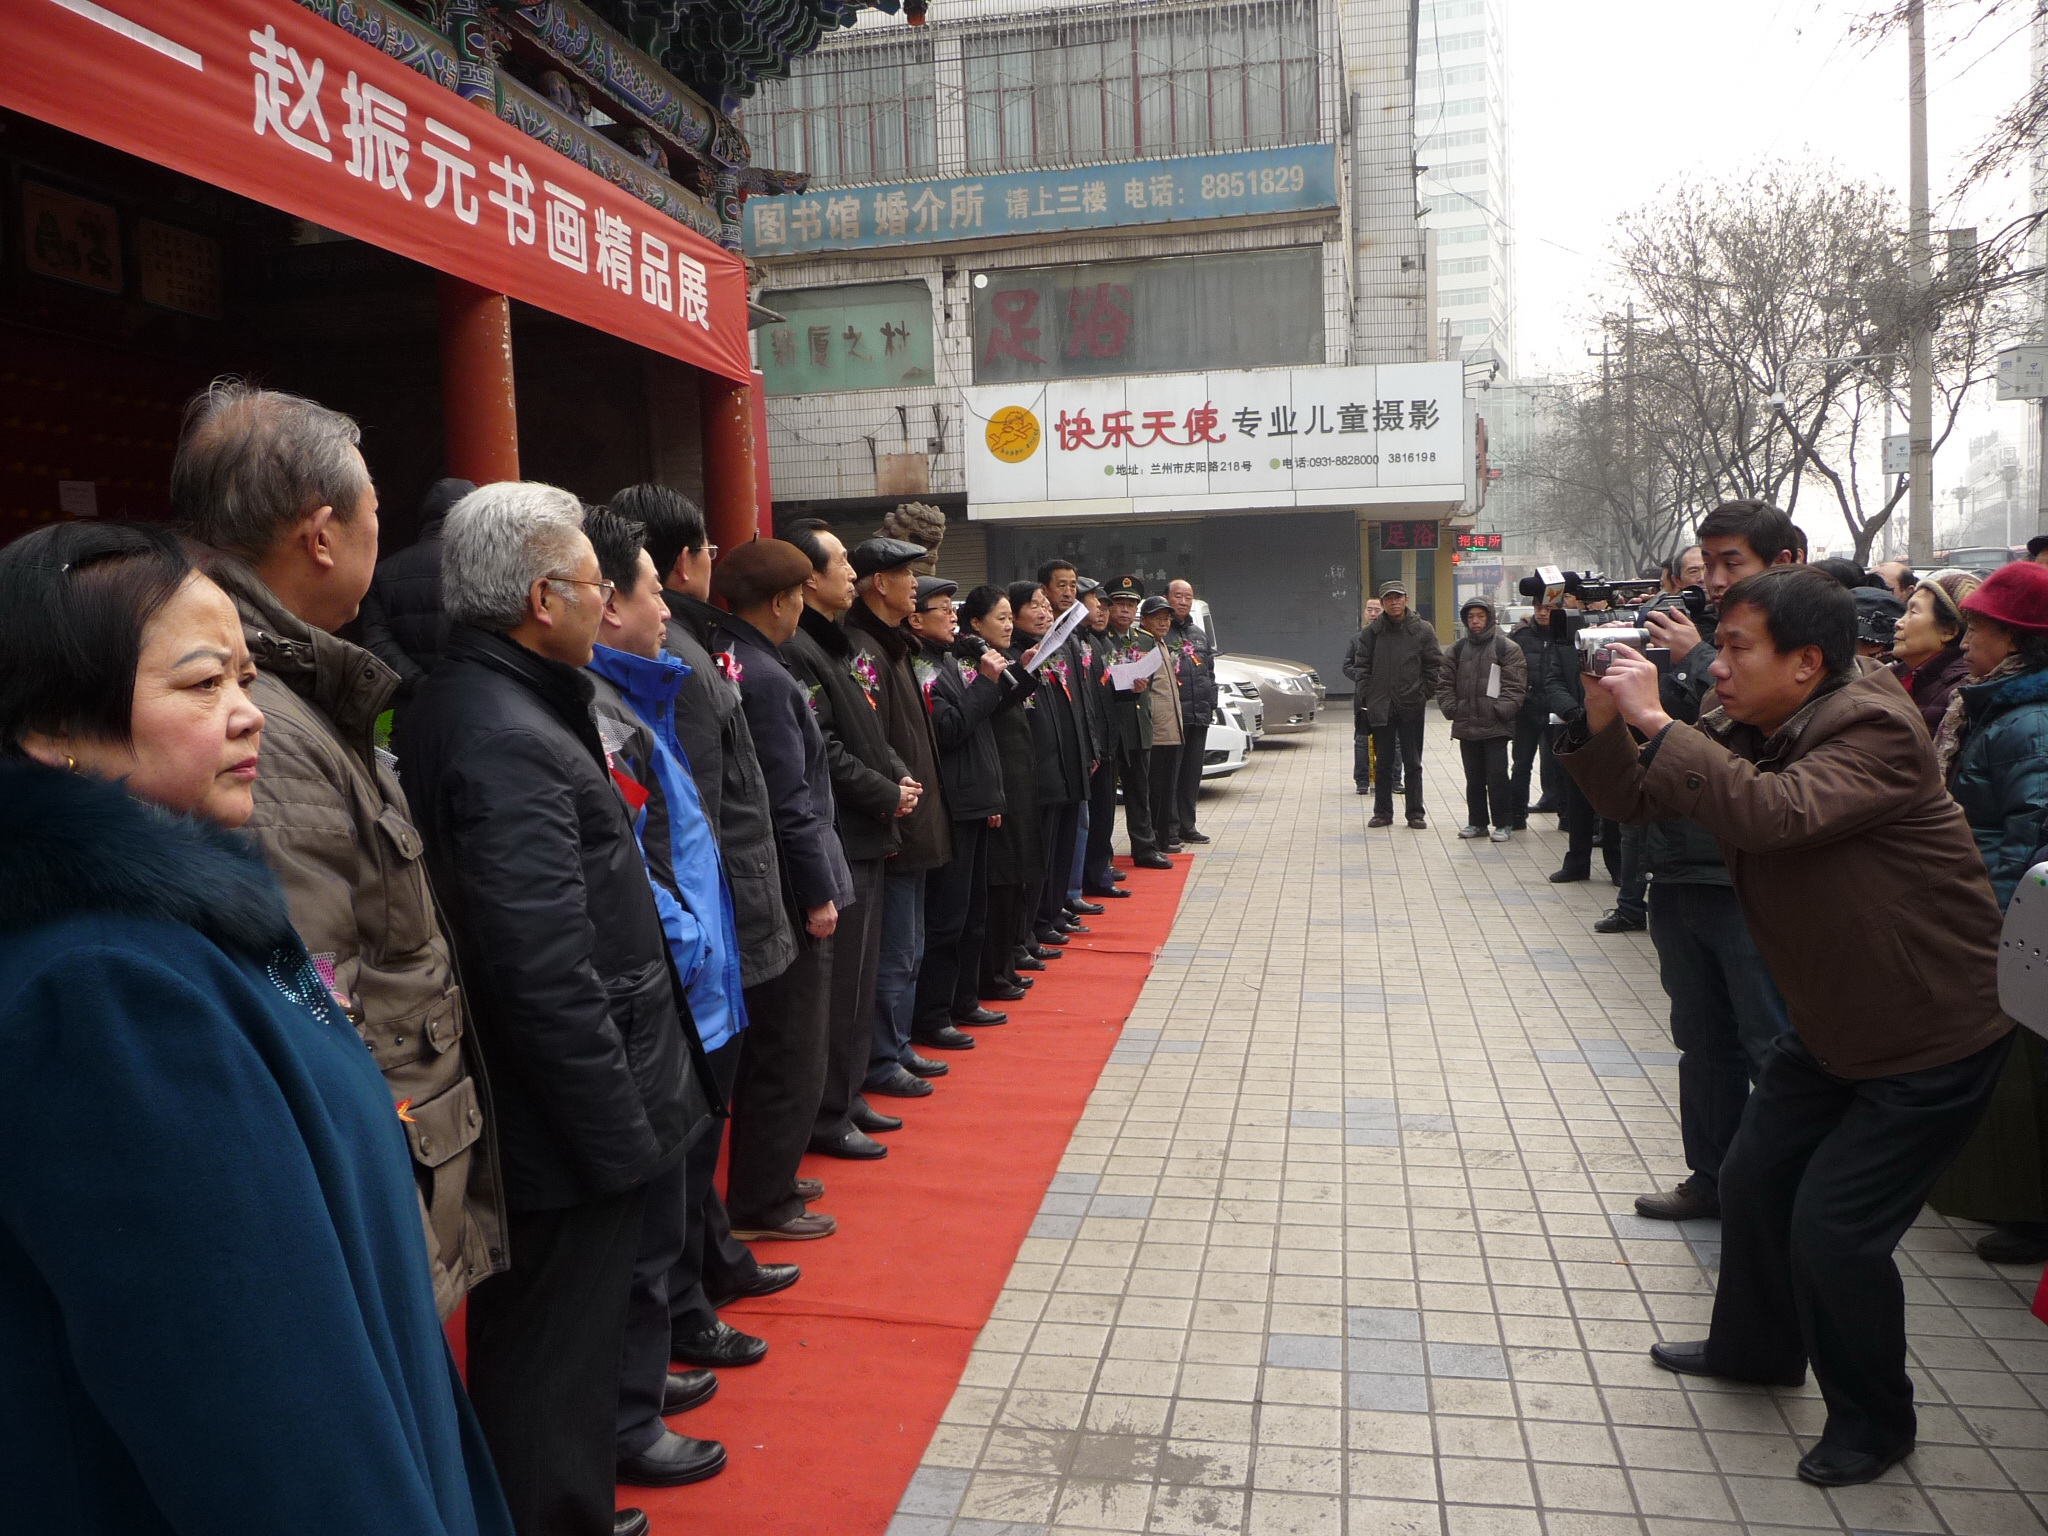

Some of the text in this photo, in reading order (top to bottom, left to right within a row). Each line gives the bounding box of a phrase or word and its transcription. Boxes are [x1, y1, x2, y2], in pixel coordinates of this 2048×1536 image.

[249, 24, 710, 331] 赵振元书画精品展
[752, 195, 861, 248] 图书馆
[873, 183, 985, 236] 婚介所
[1005, 180, 1107, 219] 请上三楼
[1201, 165, 1304, 200] 8851829
[984, 283, 1135, 367] 足浴
[1054, 399, 1440, 451] 快乐天使 专业儿童摄影
[1388, 452, 1436, 464] 3816198
[1458, 534, 1501, 547] 招待所
